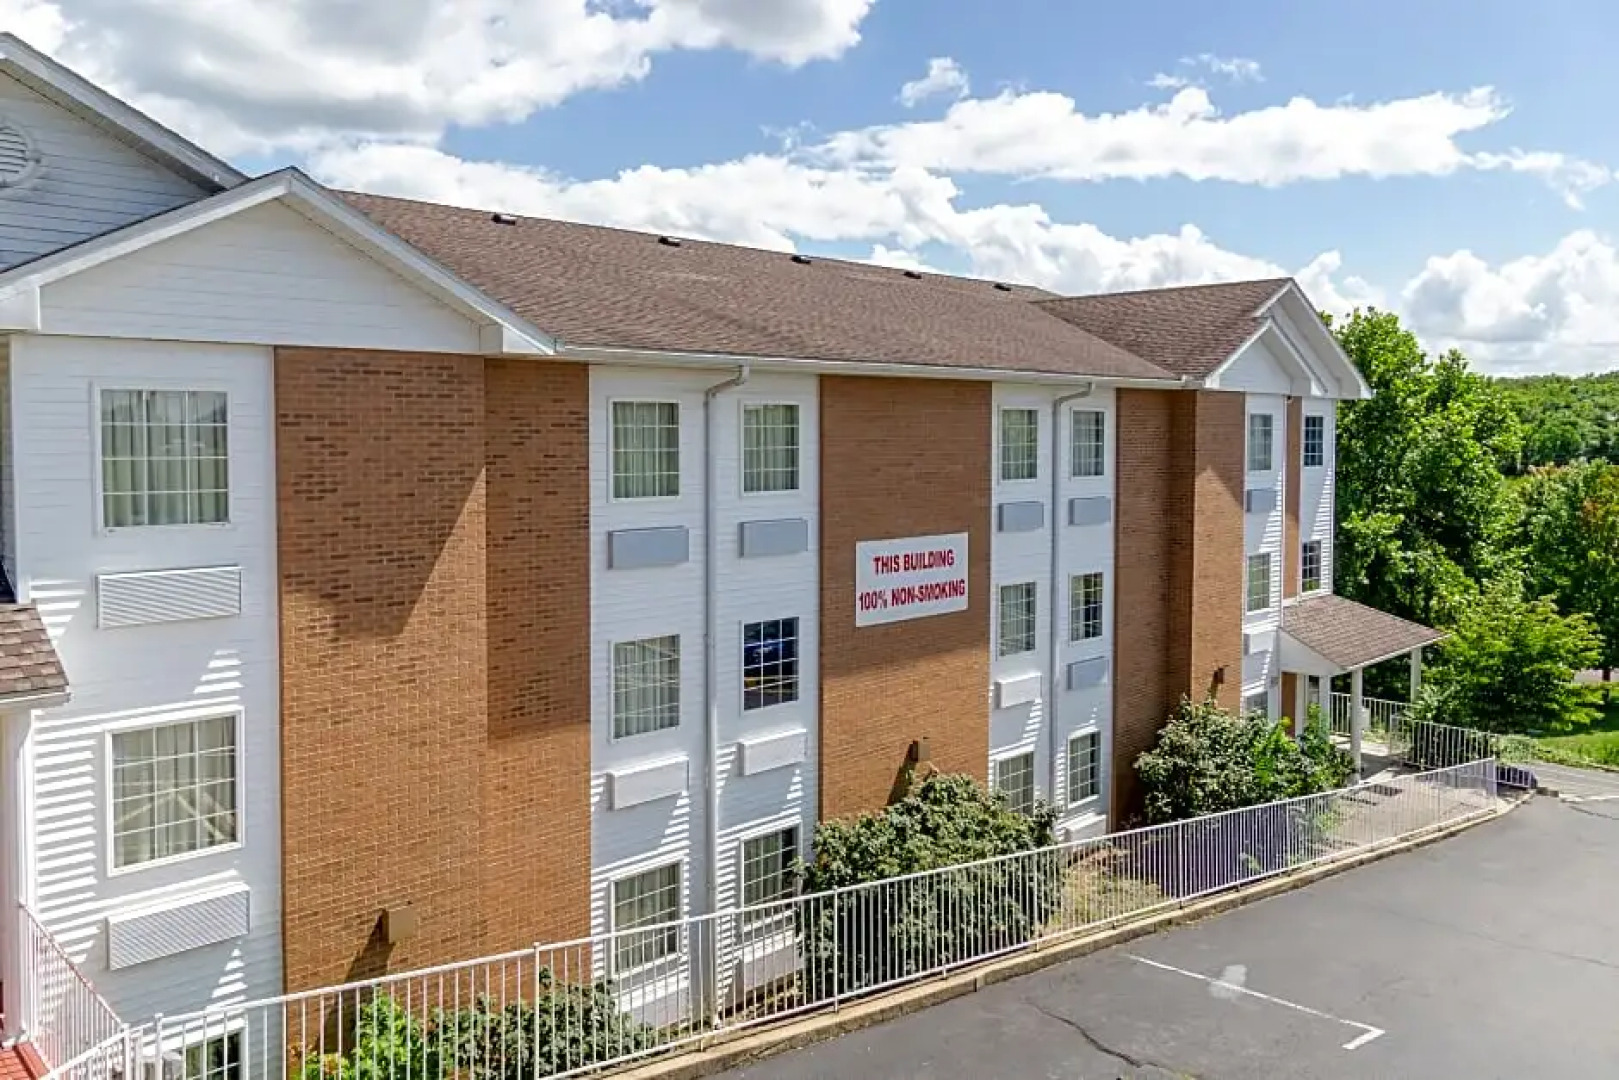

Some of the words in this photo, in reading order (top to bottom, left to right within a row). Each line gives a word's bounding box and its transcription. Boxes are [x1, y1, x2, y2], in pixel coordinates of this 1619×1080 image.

[873, 554, 900, 575] THIS
[903, 549, 955, 571] BUILDING
[859, 589, 888, 611] 100%
[891, 579, 966, 607] NON-SMOKING
